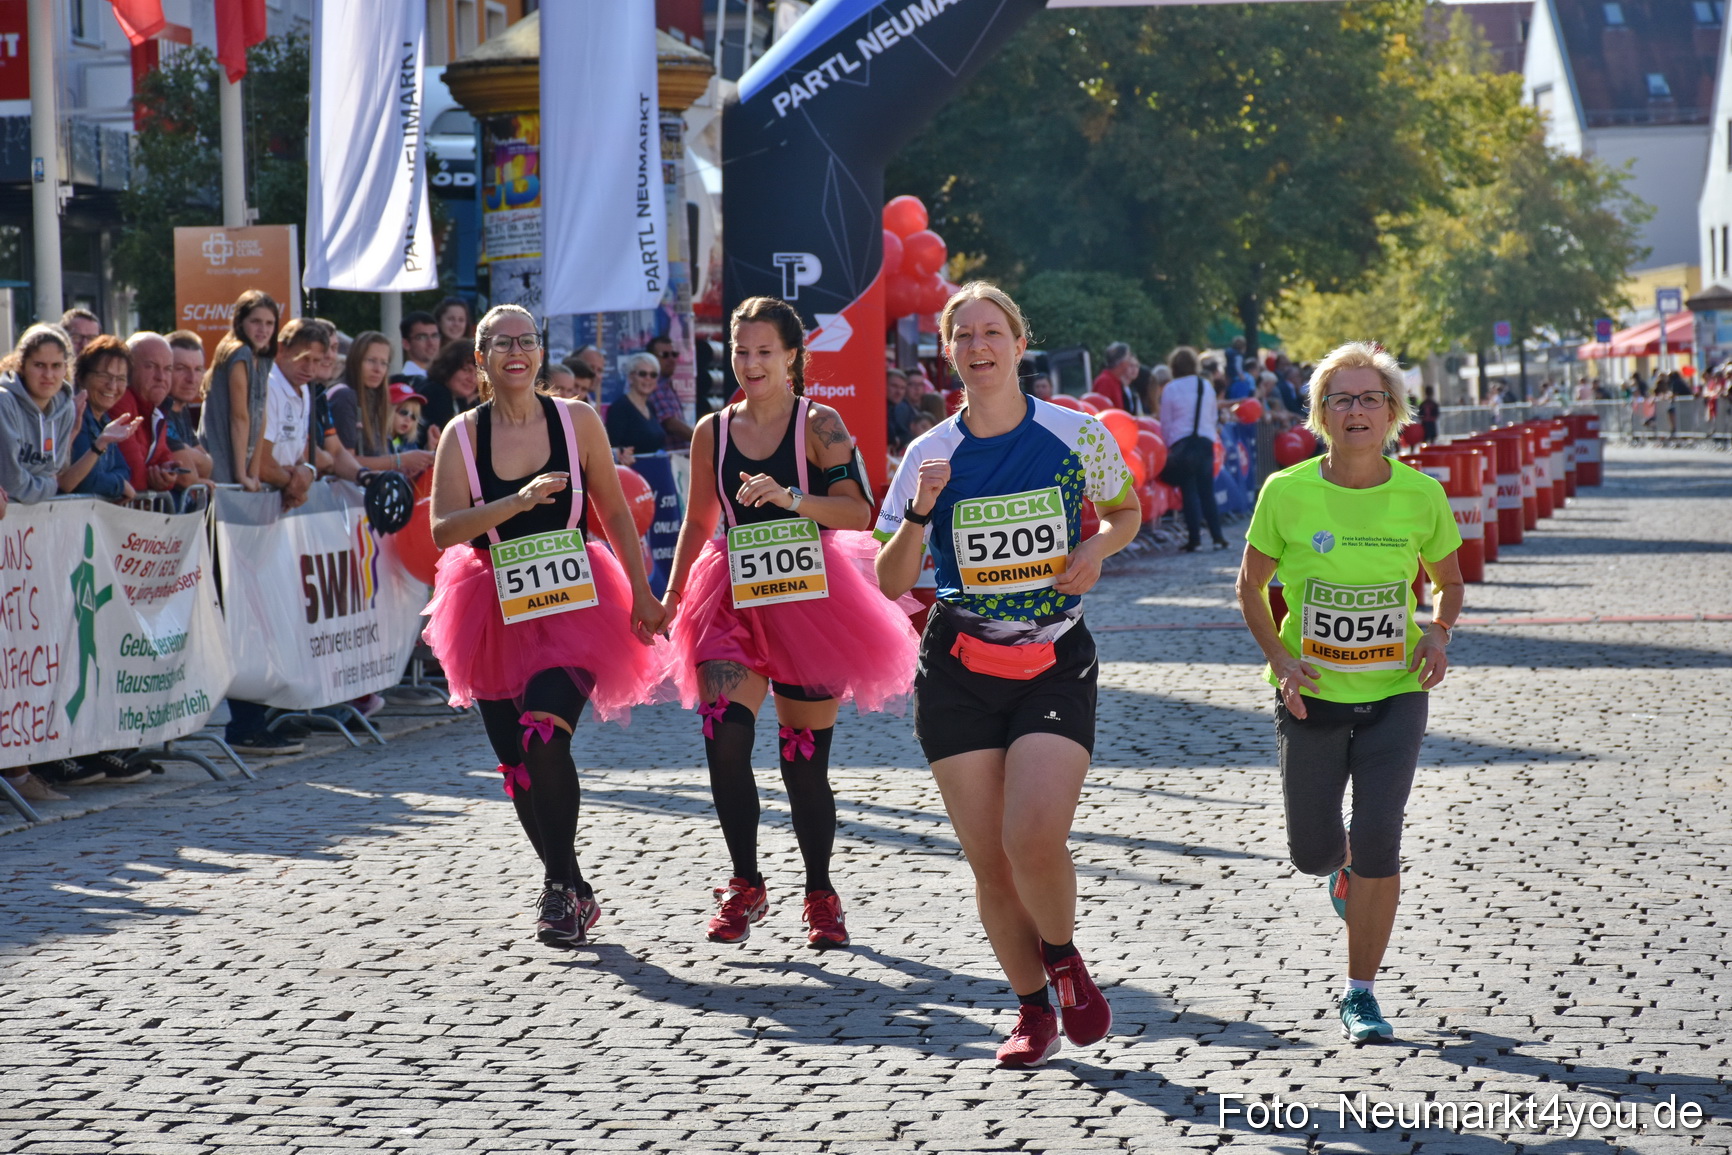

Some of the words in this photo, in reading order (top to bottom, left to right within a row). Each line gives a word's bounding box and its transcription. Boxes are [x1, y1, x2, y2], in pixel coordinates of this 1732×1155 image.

[772, 51, 861, 118] PARTL
[856, 0, 963, 60] NEUMA
[637, 92, 652, 219] NEUMARKT
[638, 222, 660, 292] PARTL
[803, 384, 855, 399] ufsport
[961, 493, 1055, 525] BOCK
[498, 533, 577, 564] BOCK
[734, 521, 813, 548] BOCK
[967, 524, 1055, 562] 5209
[506, 557, 581, 594] 5110
[740, 546, 814, 579] 5106
[977, 563, 1053, 583] CORINNA
[527, 592, 570, 609] ALINA
[751, 580, 808, 596] VERENA
[1311, 583, 1400, 609] BOCK
[1314, 612, 1394, 642] 5054
[1312, 644, 1395, 661] LIESELOTTE
